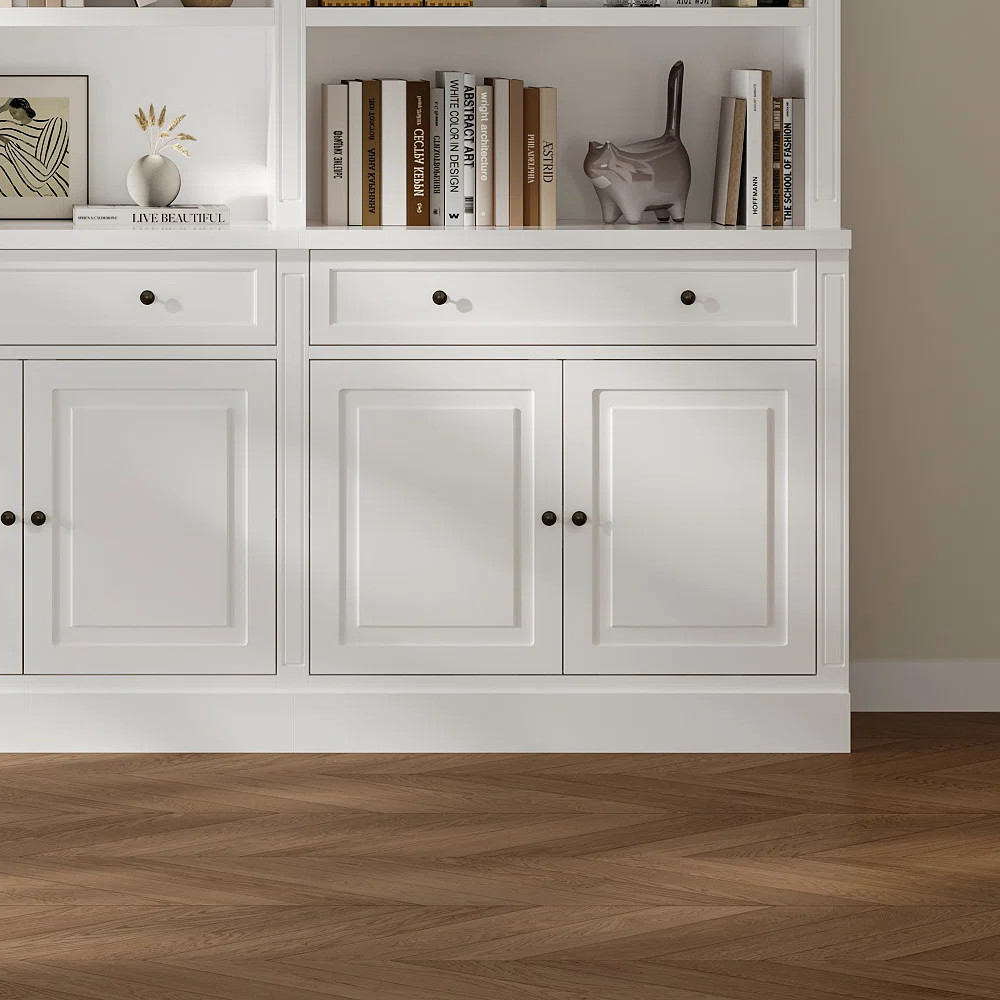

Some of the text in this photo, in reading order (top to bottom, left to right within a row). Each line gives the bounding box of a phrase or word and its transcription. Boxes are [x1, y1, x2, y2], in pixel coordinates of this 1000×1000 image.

[449, 79, 459, 193] WHITE COLOR IN DESIGN
[464, 85, 474, 168] ABSTRACT ART
[479, 92, 489, 182] wright architecture
[527, 134, 535, 184] PHILADELPHIA
[543, 140, 554, 183] ÆSTRID
[783, 123, 791, 222] THE SCHOOL OF FASHION
[132, 213, 226, 223] LIVE BEAUTIFUL
